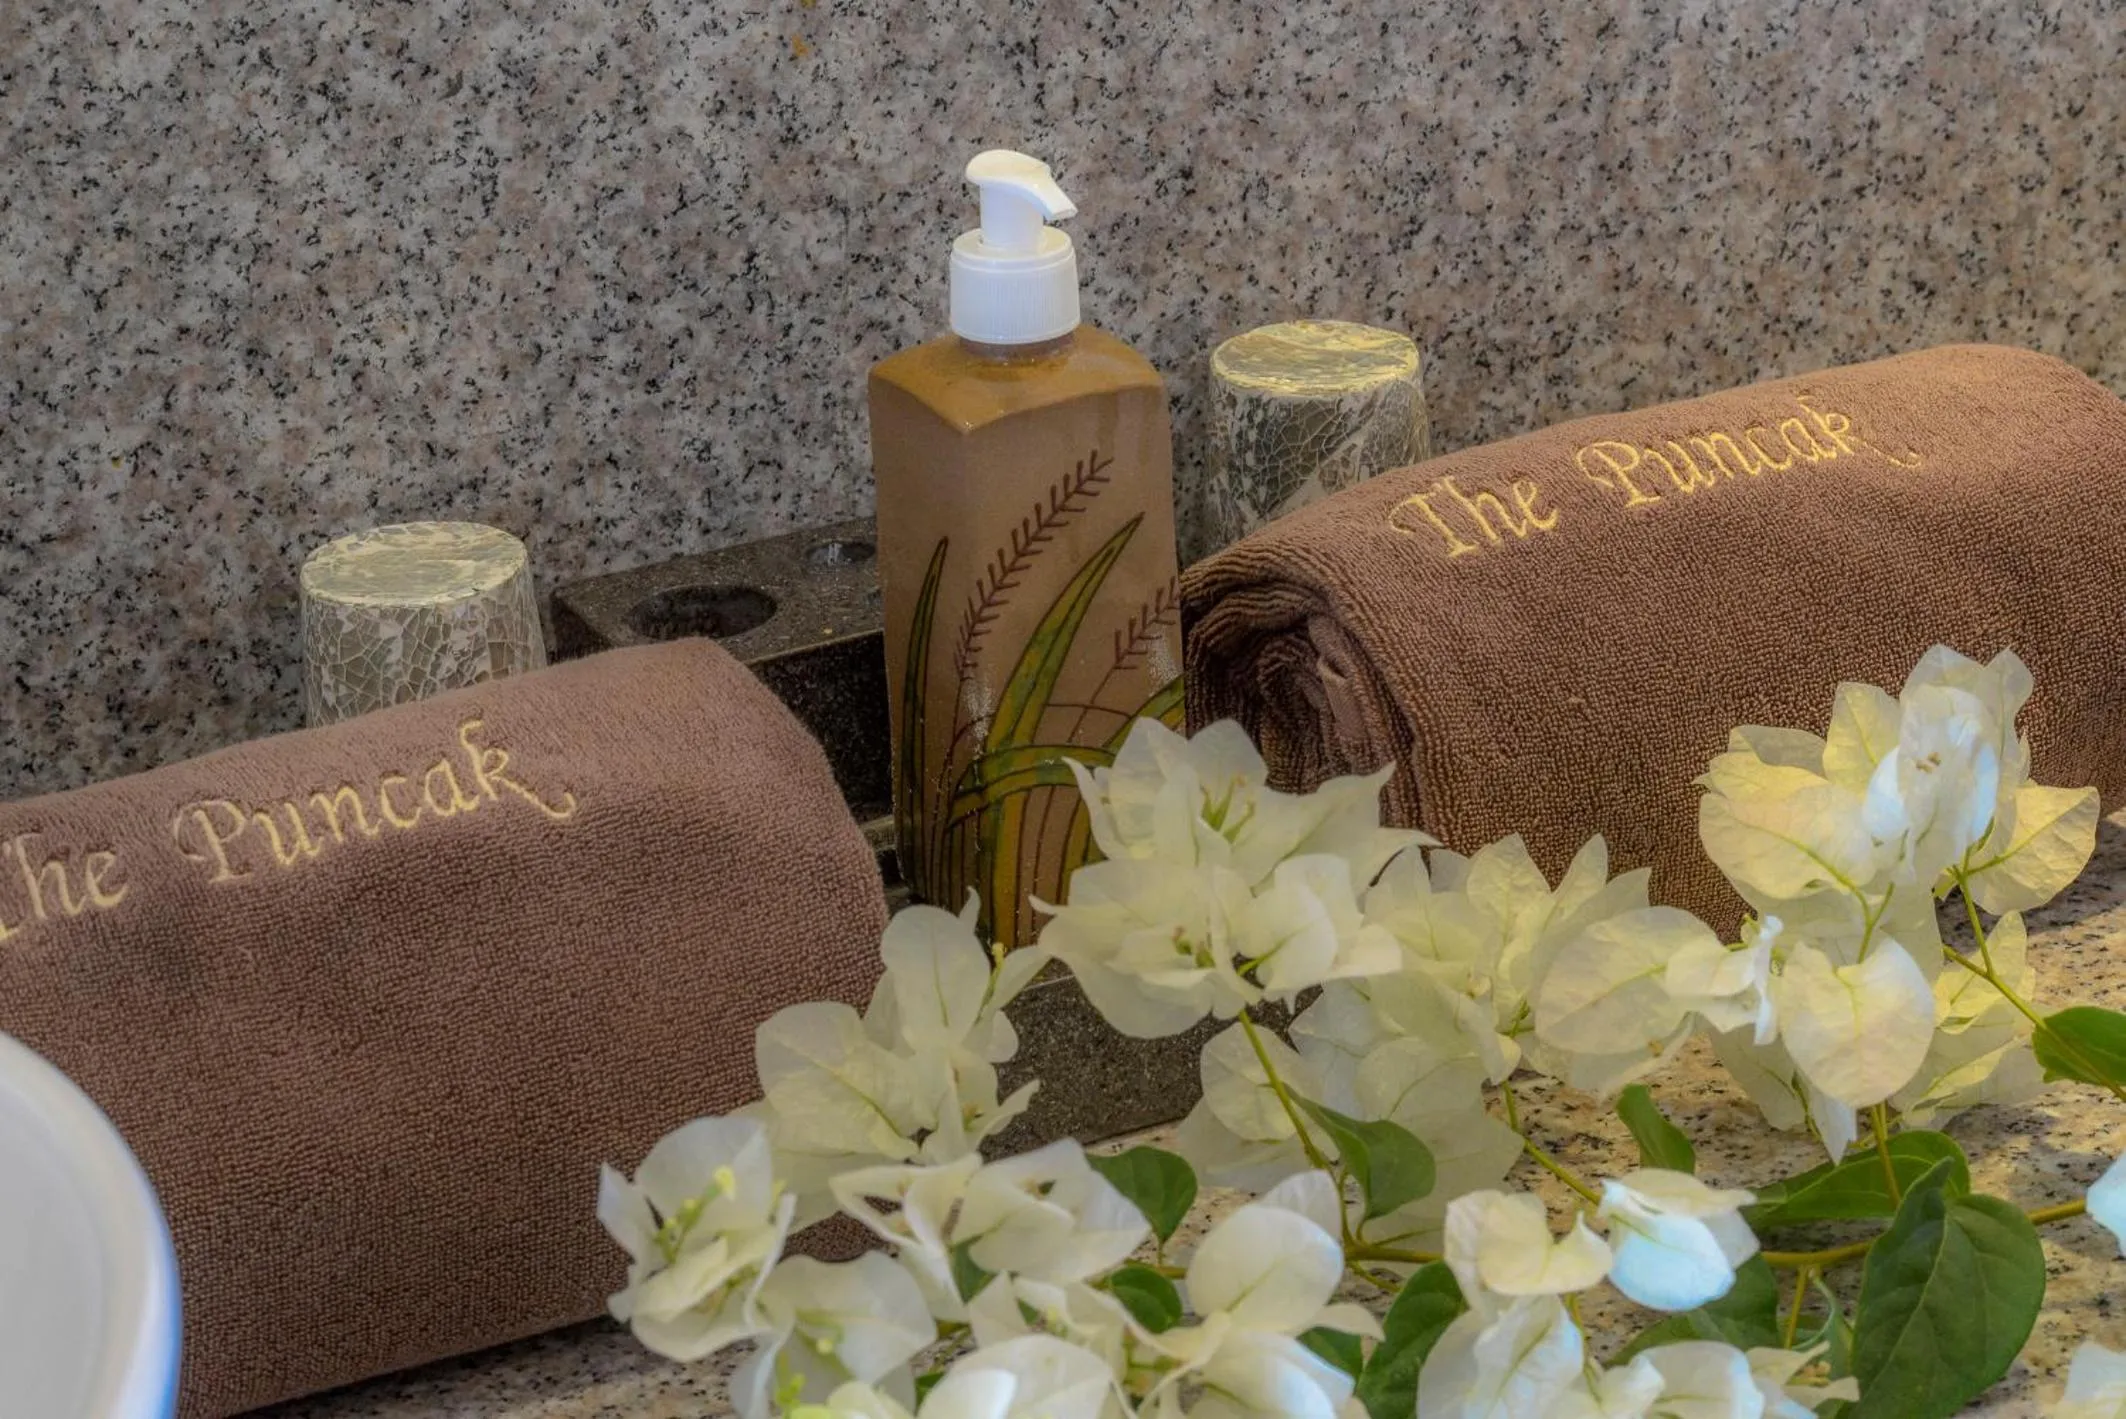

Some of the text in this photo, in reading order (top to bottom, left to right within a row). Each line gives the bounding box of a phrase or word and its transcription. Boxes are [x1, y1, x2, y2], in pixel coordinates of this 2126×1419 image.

[1387, 396, 1922, 559] The Puncak
[0, 720, 576, 940] he Puncak
